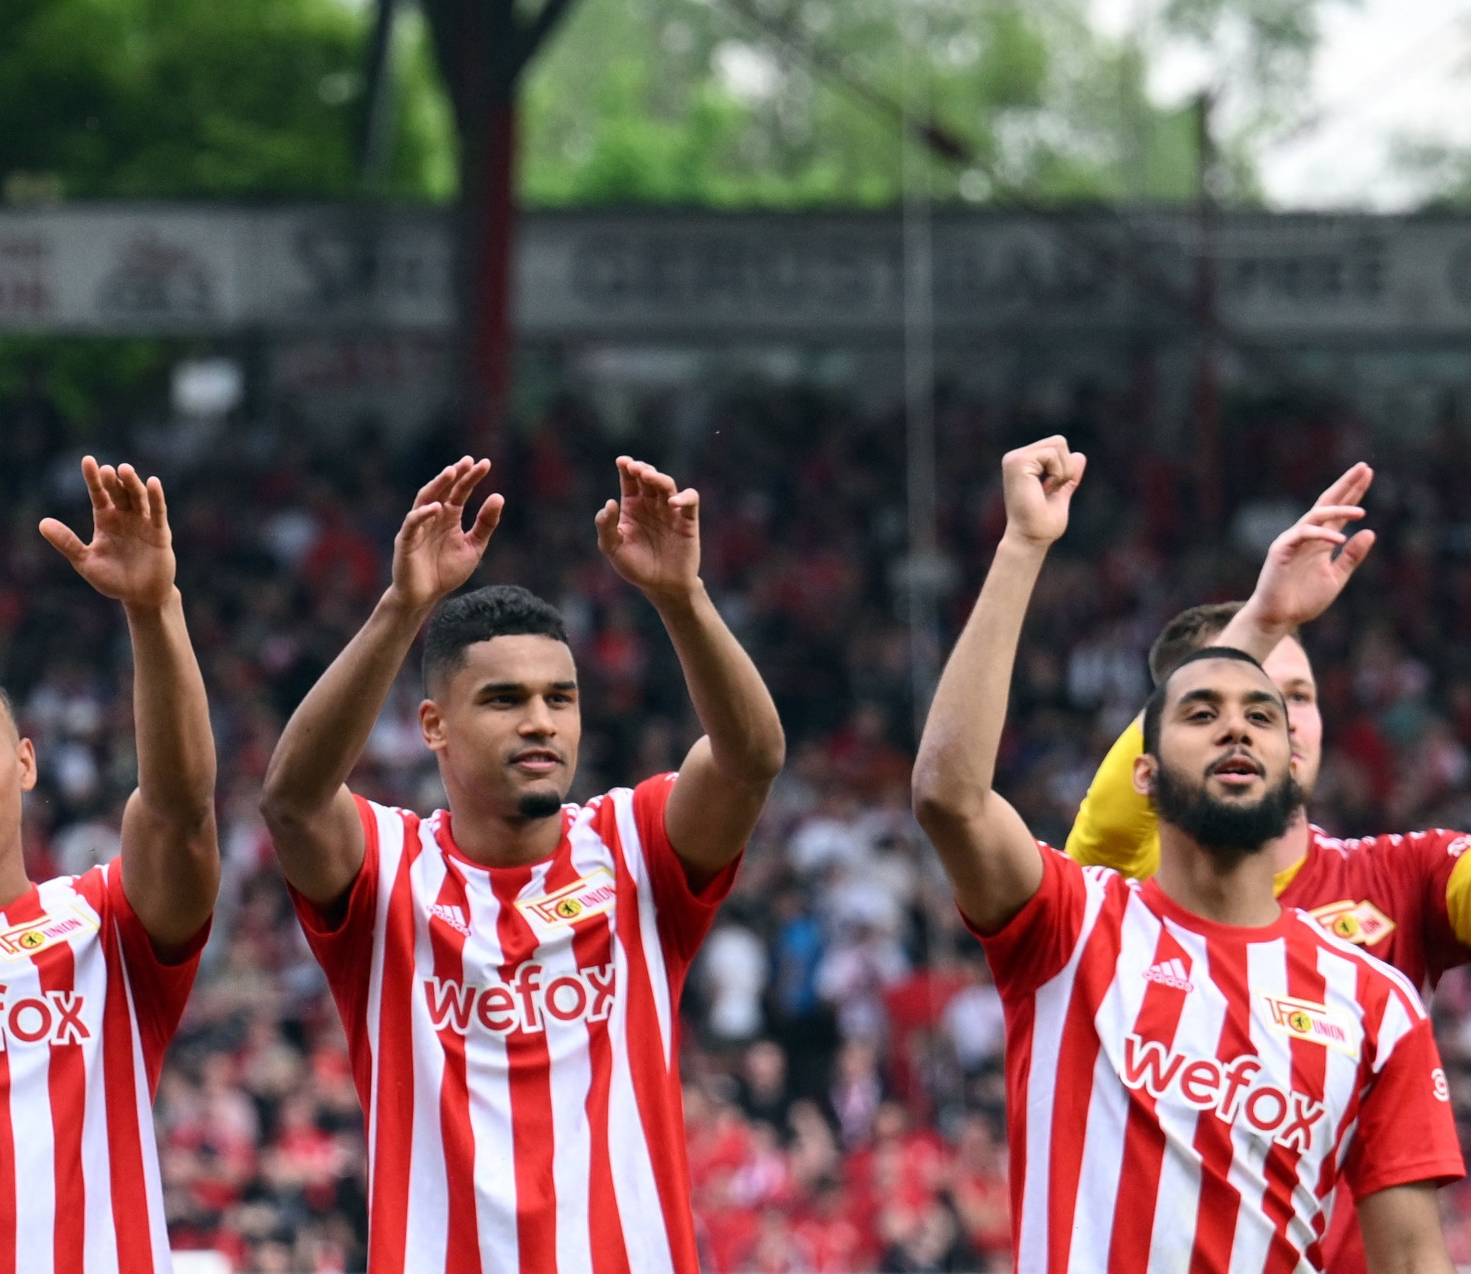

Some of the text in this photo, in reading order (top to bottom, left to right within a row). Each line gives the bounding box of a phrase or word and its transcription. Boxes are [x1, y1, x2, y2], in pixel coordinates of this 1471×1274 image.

[44, 916, 82, 939] UNION
[423, 960, 616, 1035] wefox
[1314, 1019, 1345, 1041] UNION
[1122, 1033, 1324, 1153] wefox
